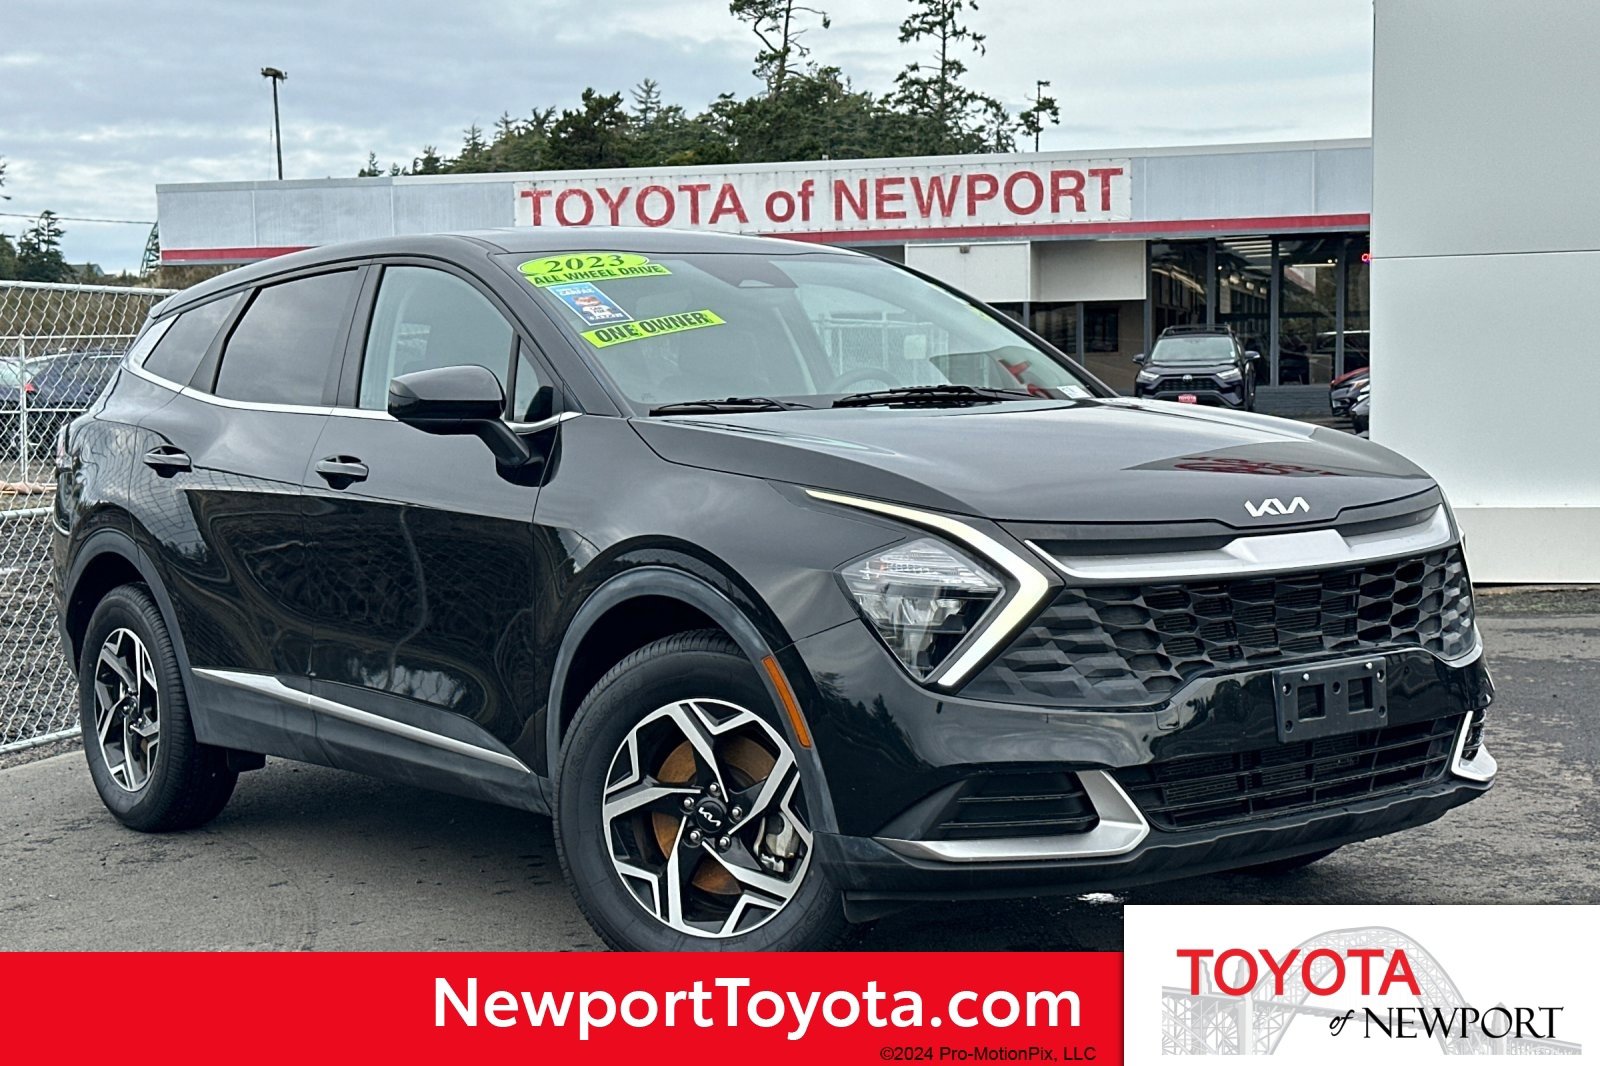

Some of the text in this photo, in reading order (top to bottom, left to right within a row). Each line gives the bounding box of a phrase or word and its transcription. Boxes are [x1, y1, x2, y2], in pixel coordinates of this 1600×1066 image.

[521, 168, 1123, 226] TOYOTA of NEWPORT
[544, 254, 625, 273] 2023
[534, 264, 663, 285] ALL WHEEL DRIVE
[594, 324, 641, 343] ONE
[639, 312, 708, 334] OWNER
[1244, 496, 1310, 517] KIA
